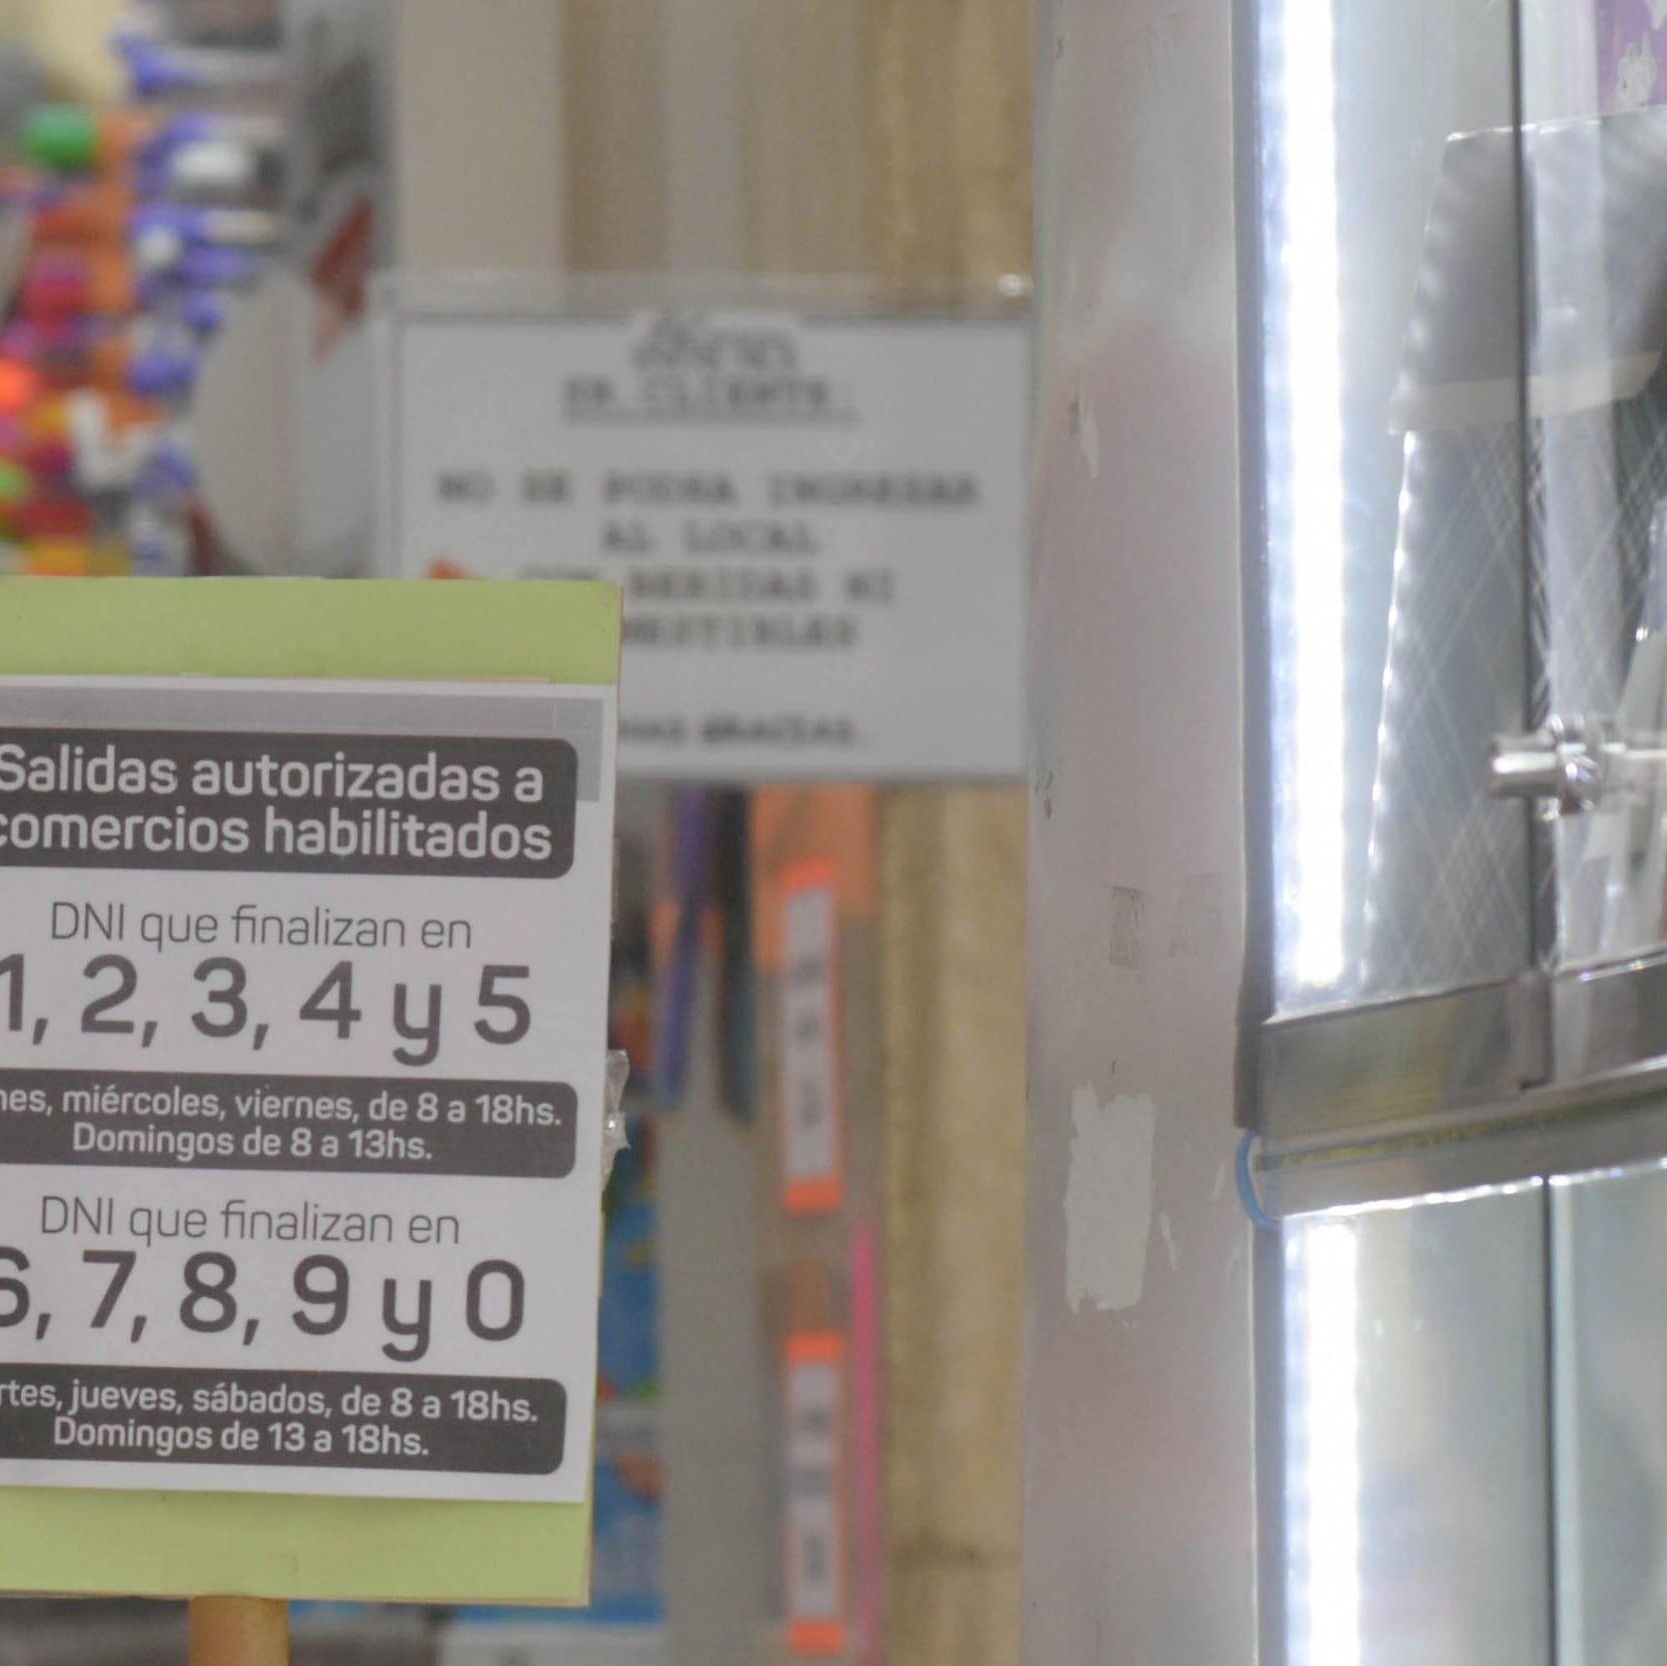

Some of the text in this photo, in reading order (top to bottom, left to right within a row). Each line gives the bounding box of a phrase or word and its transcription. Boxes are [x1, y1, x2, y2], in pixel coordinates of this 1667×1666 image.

[192, 751, 500, 802] autorizadas
[514, 767, 543, 803] a
[265, 805, 552, 861] habilitados
[51, 901, 472, 953] DNI que finalizan en
[298, 960, 362, 1040] 4
[392, 983, 442, 1067] y
[473, 964, 531, 1045] 5
[62, 1083, 226, 1121] miércoles,
[234, 1088, 360, 1124] viernes,
[368, 1090, 408, 1122] de
[416, 1091, 439, 1123] 8
[447, 1100, 466, 1123] a
[474, 1093, 562, 1126] 18hs.
[73, 1121, 433, 1163] Domingos de 8 a 13hs.
[41, 1195, 460, 1249] DNI que finalizan en
[291, 1254, 350, 1336] 9
[381, 1278, 433, 1363] y
[465, 1259, 525, 1342] 0
[67, 1378, 183, 1416] jueves,
[192, 1381, 332, 1419] sábados,
[341, 1384, 382, 1417] de
[390, 1386, 413, 1418] 8
[421, 1395, 441, 1419] a
[450, 1389, 538, 1422] 18hs.
[54, 1415, 429, 1457] Domingos de 13 a 18hs.
